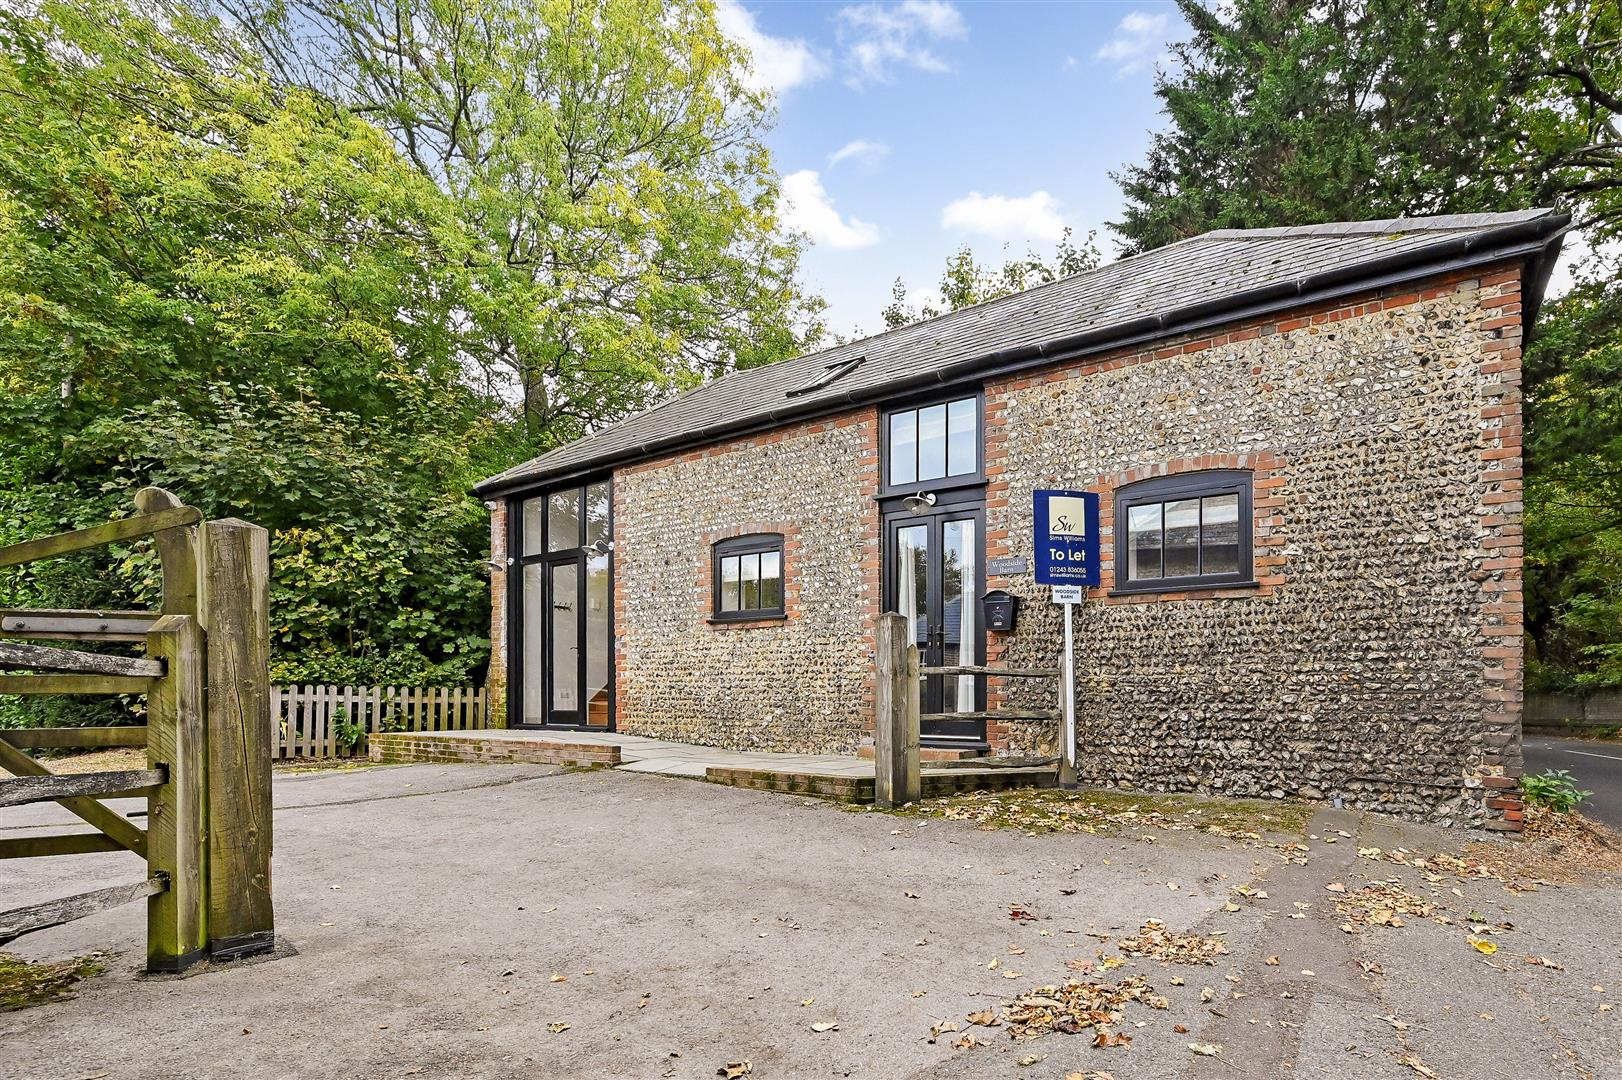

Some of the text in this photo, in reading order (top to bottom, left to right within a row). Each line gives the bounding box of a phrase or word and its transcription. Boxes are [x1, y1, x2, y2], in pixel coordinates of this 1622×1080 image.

[1049, 548, 1086, 561] To Let
[991, 560, 1023, 568] Woodside
[1067, 566, 1087, 574] 836055
